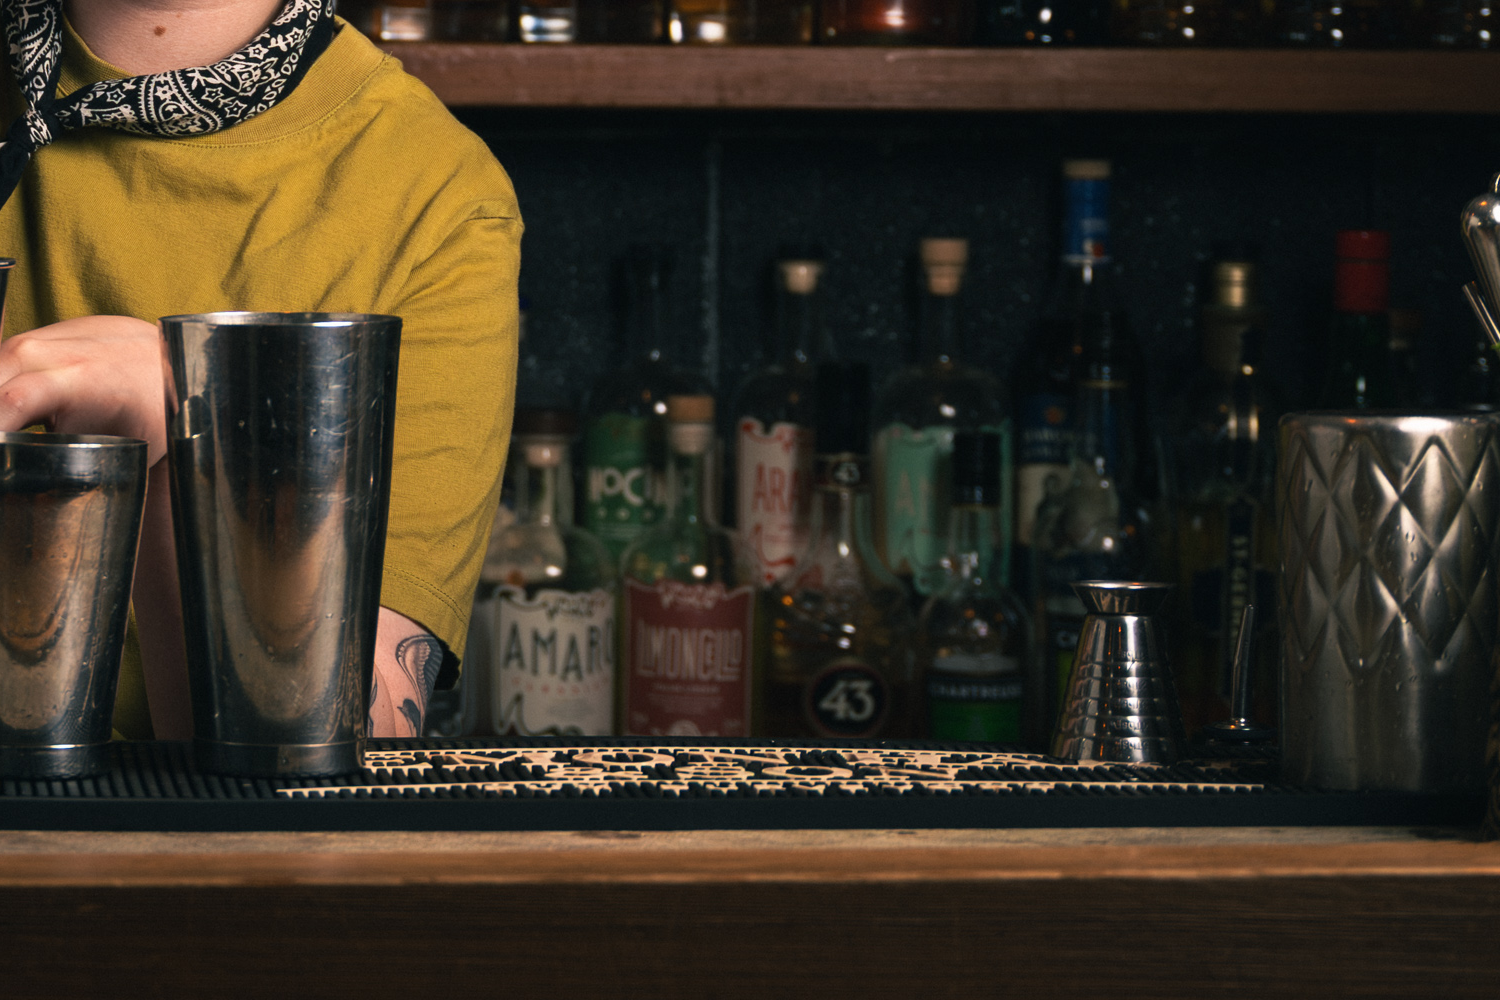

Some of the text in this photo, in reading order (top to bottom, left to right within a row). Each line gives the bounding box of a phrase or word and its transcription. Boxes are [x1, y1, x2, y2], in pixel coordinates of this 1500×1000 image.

[818, 679, 876, 723] 43
[364, 750, 801, 769] EMON
[675, 765, 968, 779] SON
